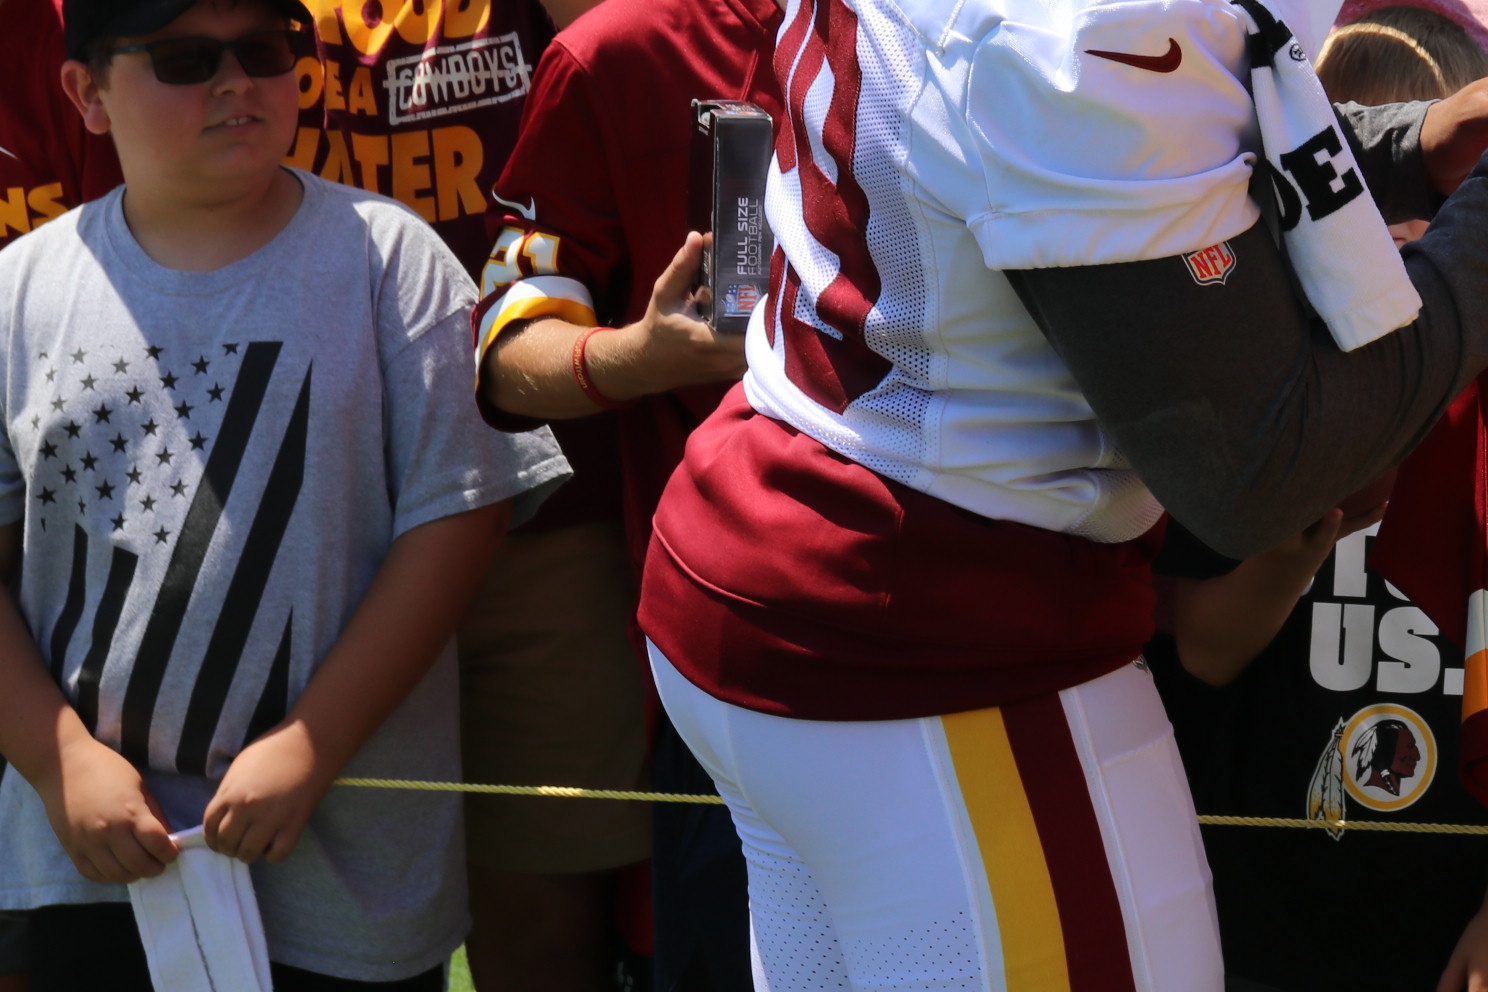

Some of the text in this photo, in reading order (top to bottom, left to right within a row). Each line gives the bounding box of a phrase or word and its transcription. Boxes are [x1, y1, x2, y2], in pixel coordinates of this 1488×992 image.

[399, 45, 517, 111] COWBOYS
[737, 196, 749, 275] FULL SIZE
[748, 198, 759, 275] FOOTBALL
[1190, 244, 1232, 279] NFL
[737, 283, 758, 311] NFL
